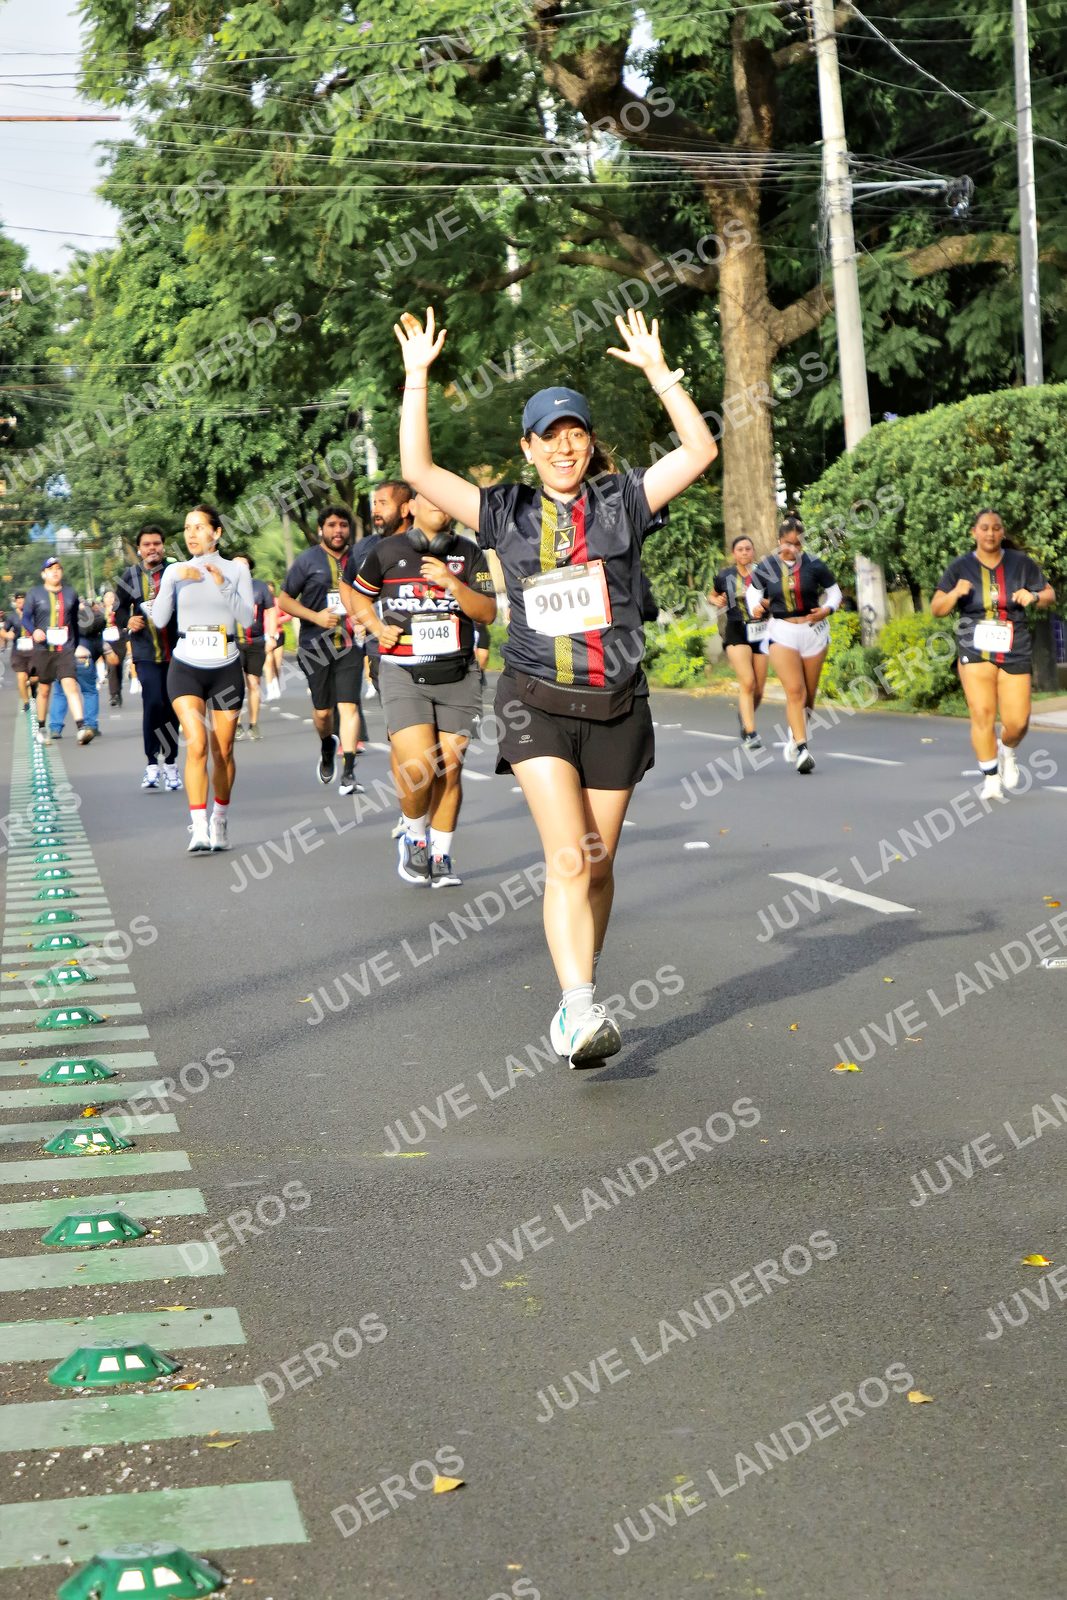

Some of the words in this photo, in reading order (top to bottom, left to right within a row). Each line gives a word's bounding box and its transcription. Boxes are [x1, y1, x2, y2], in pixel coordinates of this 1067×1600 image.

[535, 587, 590, 615] 9010
[419, 625, 450, 640] 9048
[191, 635, 218, 647] 6912
